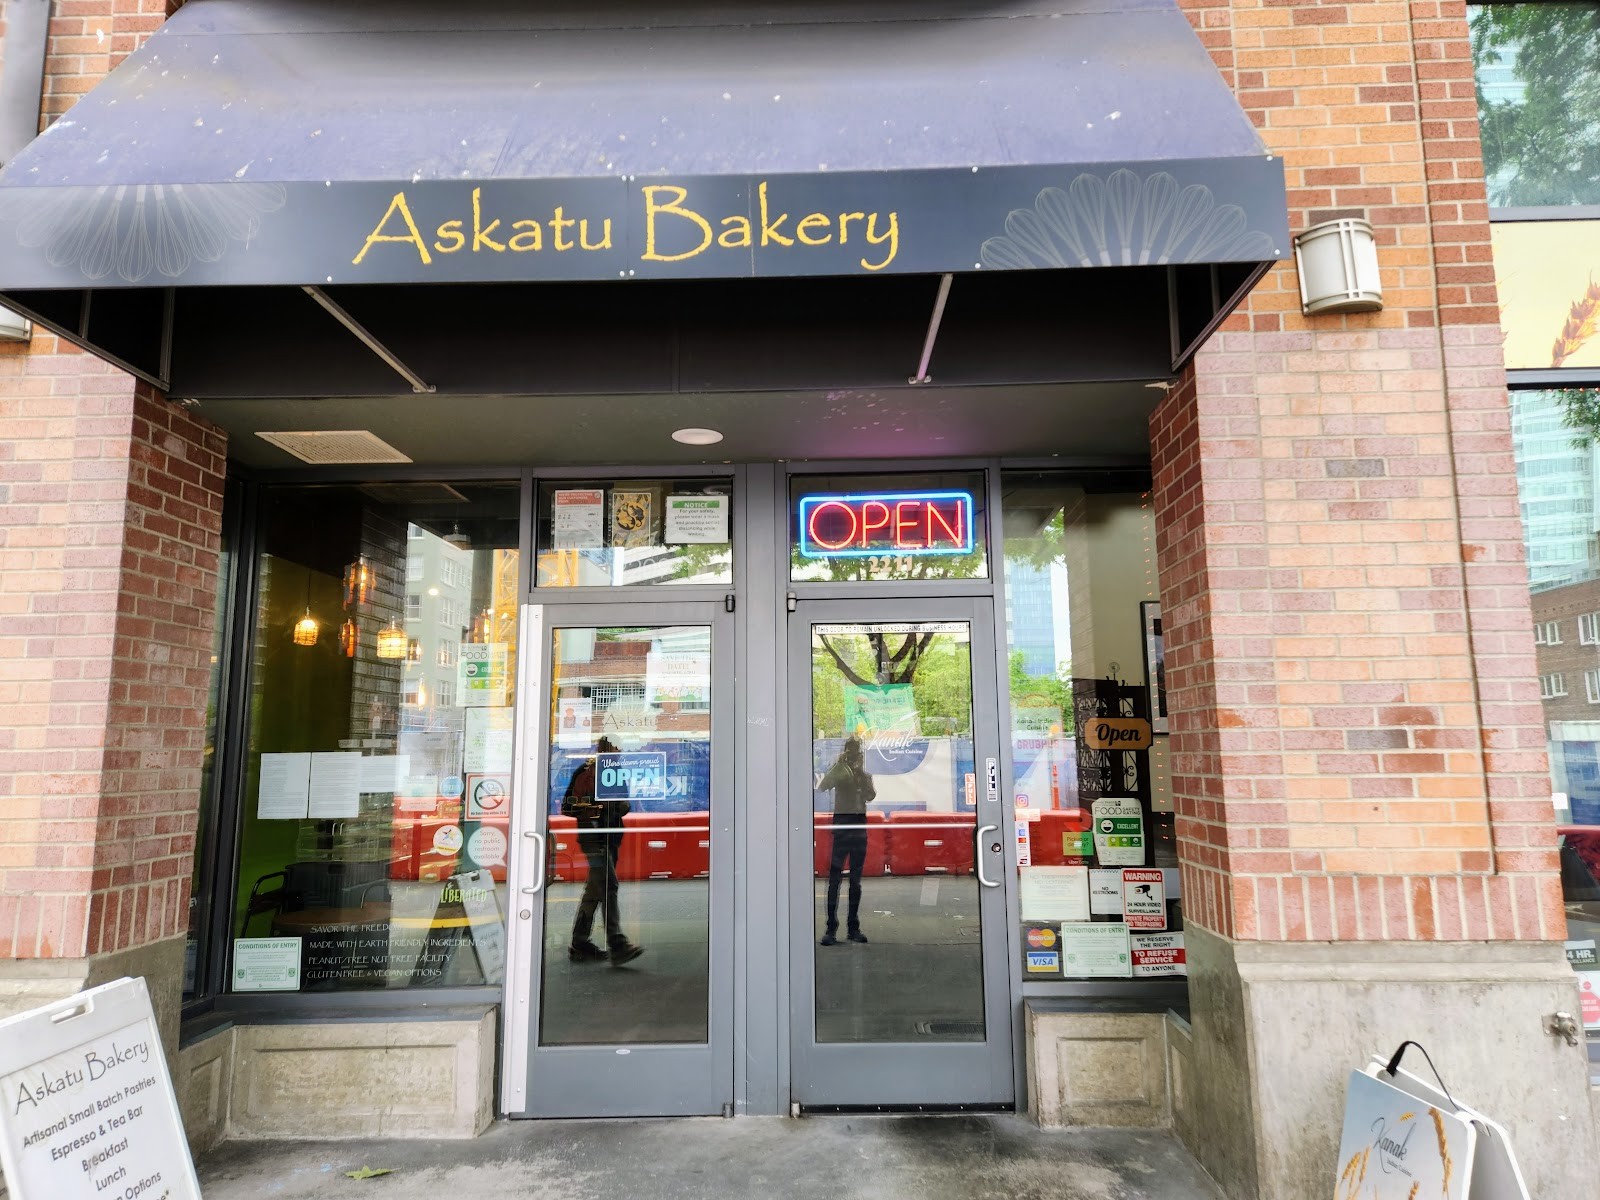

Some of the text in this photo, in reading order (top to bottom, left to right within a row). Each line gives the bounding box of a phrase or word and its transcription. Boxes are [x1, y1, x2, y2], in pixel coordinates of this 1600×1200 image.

[352, 181, 900, 271] Askatu Bakery
[809, 500, 963, 549] OPEN
[867, 555, 913, 573] 2211
[461, 651, 488, 660] FOOD
[603, 710, 658, 730] Askatu
[1095, 723, 1142, 747] Open
[621, 756, 639, 766] damn
[640, 756, 660, 768] proud
[601, 768, 660, 787] OPEN
[1095, 807, 1122, 815] FOOD
[1124, 872, 1161, 880] WARNING
[440, 887, 487, 903] LIBERATED
[310, 925, 339, 933] SAVOR
[336, 940, 357, 948] WITH
[430, 939, 487, 947] INGREDIENTS
[371, 955, 389, 963] NUT
[391, 955, 413, 963] FREE
[415, 954, 452, 962] FACILITY
[1147, 949, 1178, 957] REFUSE
[1576, 949, 1595, 959] HR.
[1032, 958, 1054, 966] VISA
[374, 969, 402, 977] VEGAN
[15, 1041, 149, 1115] Askatu Bakery
[23, 1076, 156, 1148] Artisanal Small Batch Pastries
[51, 1104, 144, 1161] Espresso & Tea Bar
[81, 1137, 129, 1172] Breakfast
[96, 1165, 127, 1191] Lunch
[125, 1172, 162, 1200] Options
